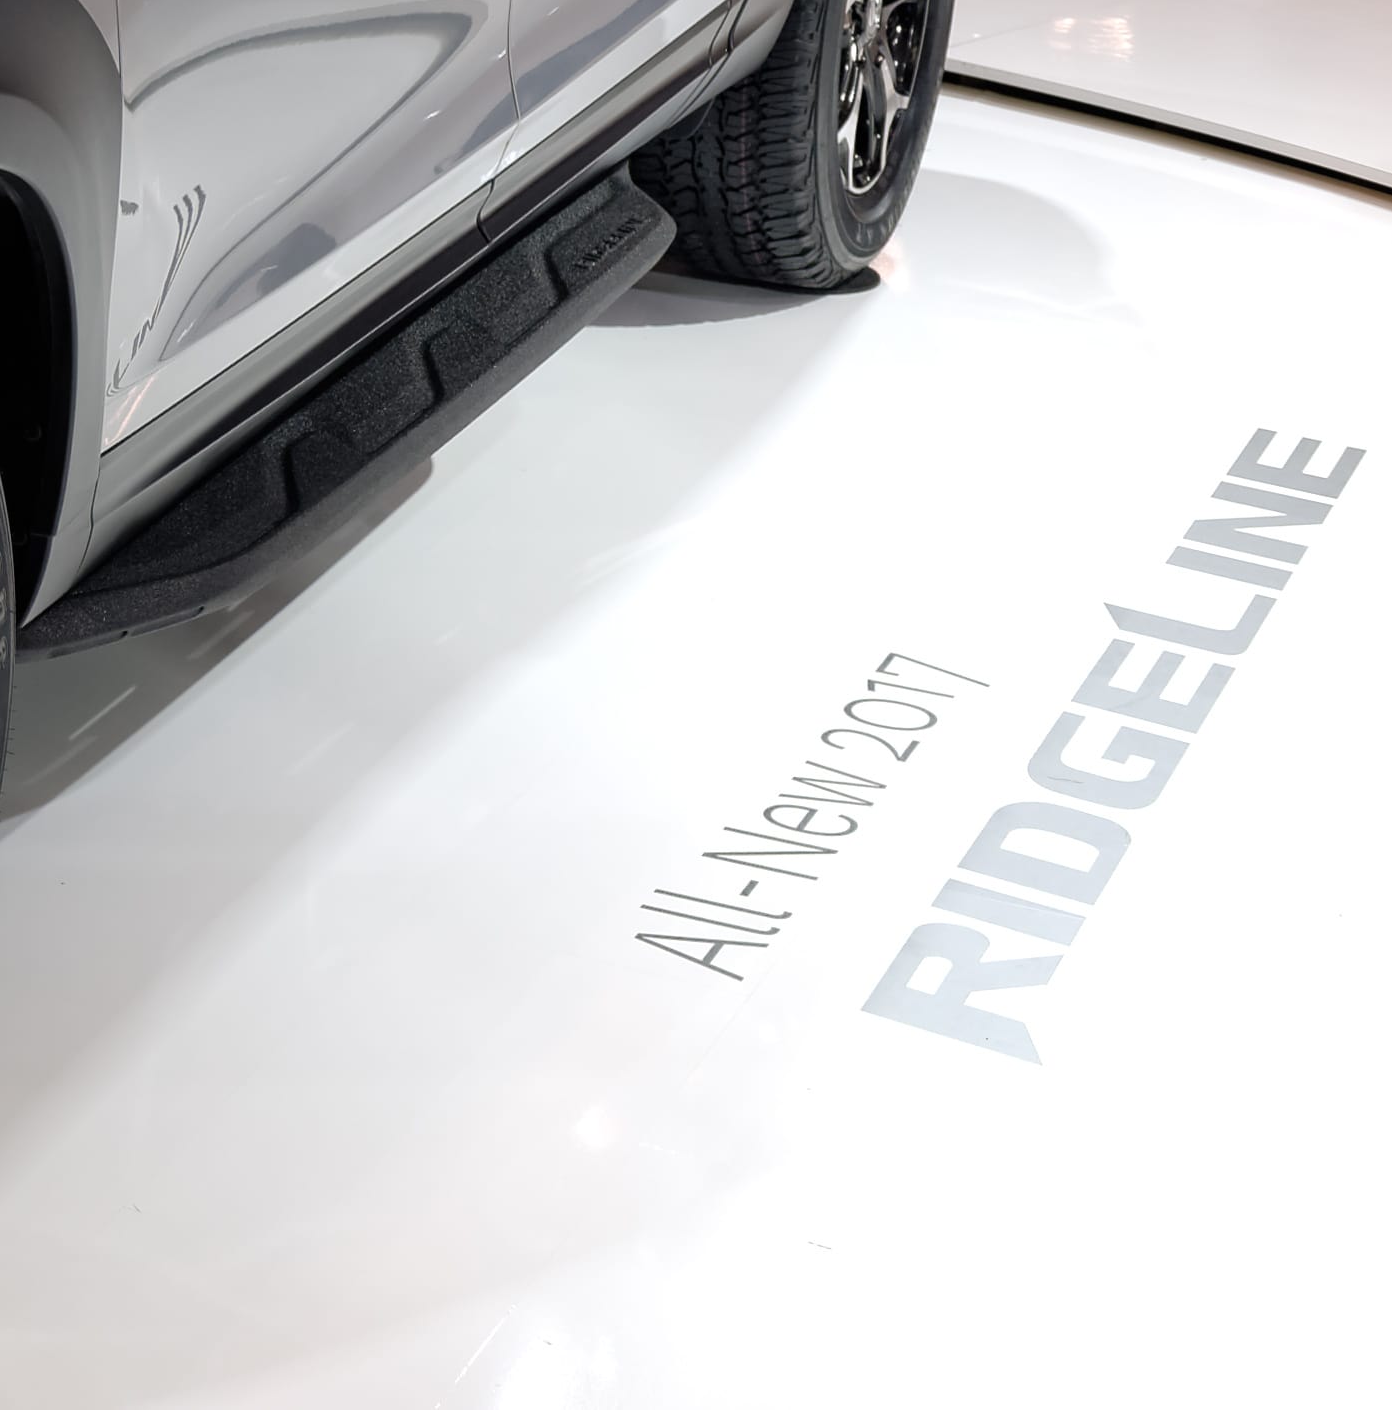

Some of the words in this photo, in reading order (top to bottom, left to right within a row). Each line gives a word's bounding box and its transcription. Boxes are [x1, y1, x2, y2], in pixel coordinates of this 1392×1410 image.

[633, 759, 888, 983] All-New
[819, 651, 991, 763] 2017
[860, 427, 1368, 1066] RIDGELINE
